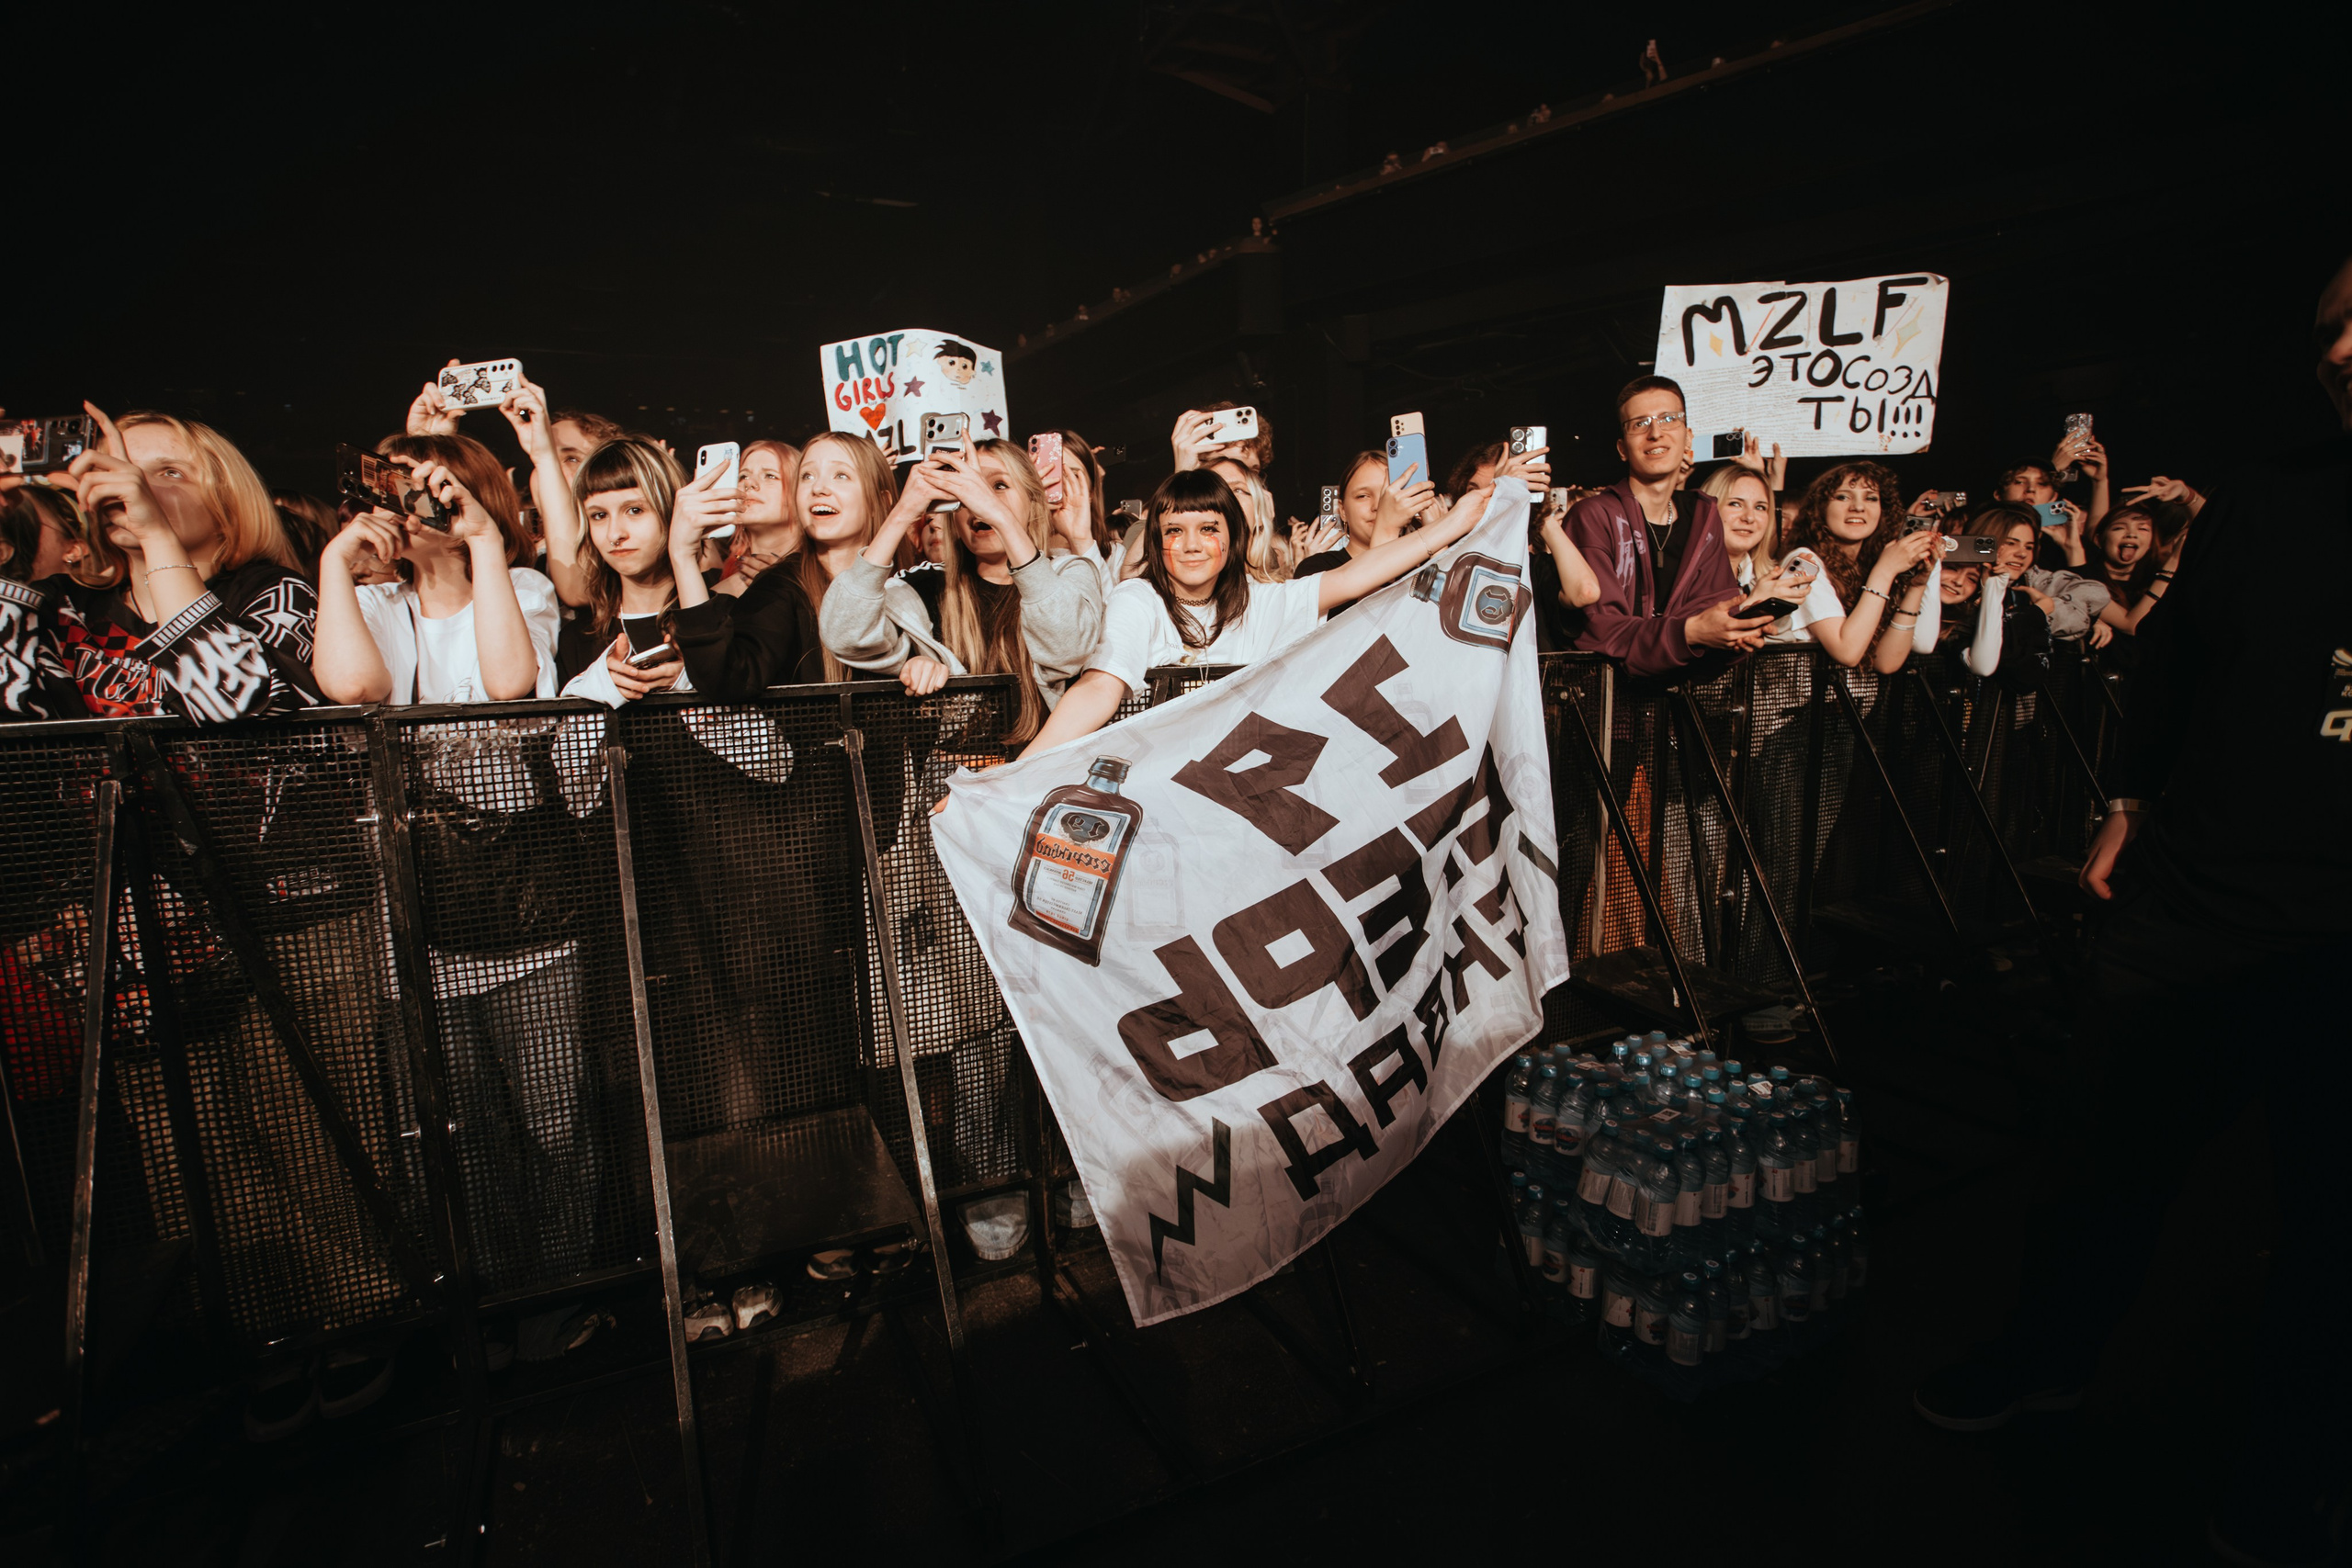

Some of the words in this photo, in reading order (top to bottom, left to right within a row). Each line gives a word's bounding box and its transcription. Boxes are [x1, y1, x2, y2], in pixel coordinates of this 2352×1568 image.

[1681, 276, 1928, 367] MZLF
[835, 333, 905, 382] HOT
[834, 371, 895, 412] GIRLS
